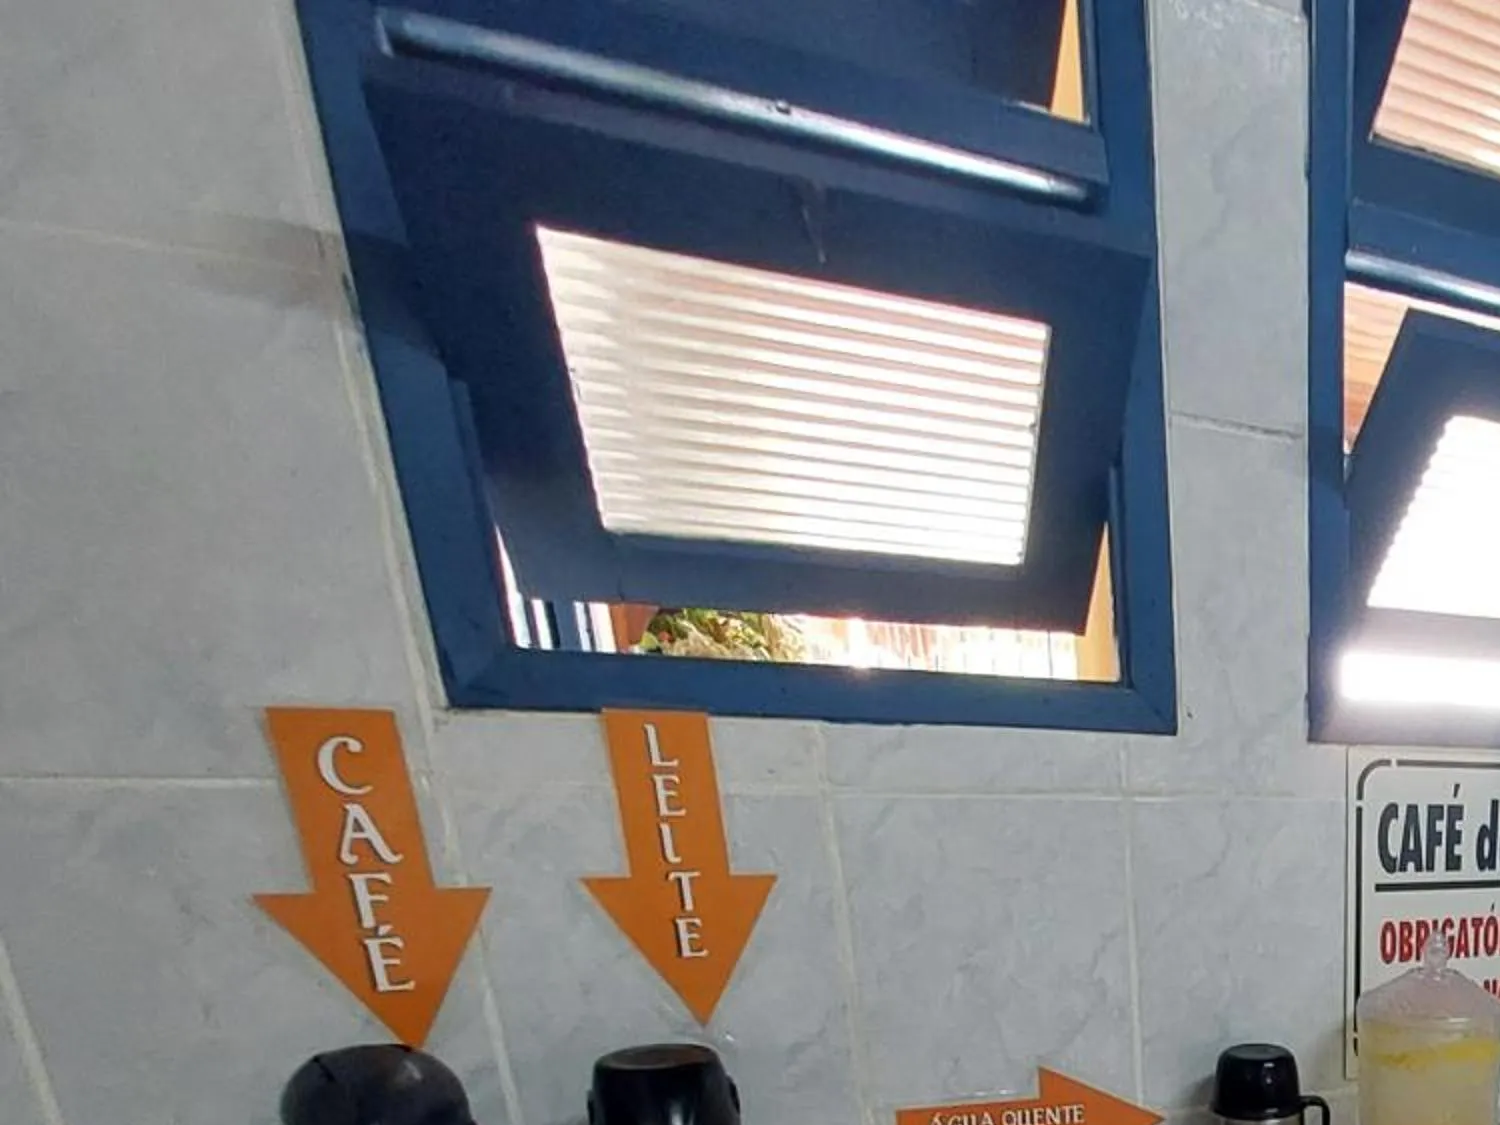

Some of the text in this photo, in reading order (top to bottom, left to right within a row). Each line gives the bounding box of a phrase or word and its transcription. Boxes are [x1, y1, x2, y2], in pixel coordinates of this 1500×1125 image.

[316, 736, 416, 993] CAFÉ
[643, 723, 709, 959] LEITE
[1377, 783, 1464, 874] CAFÉ
